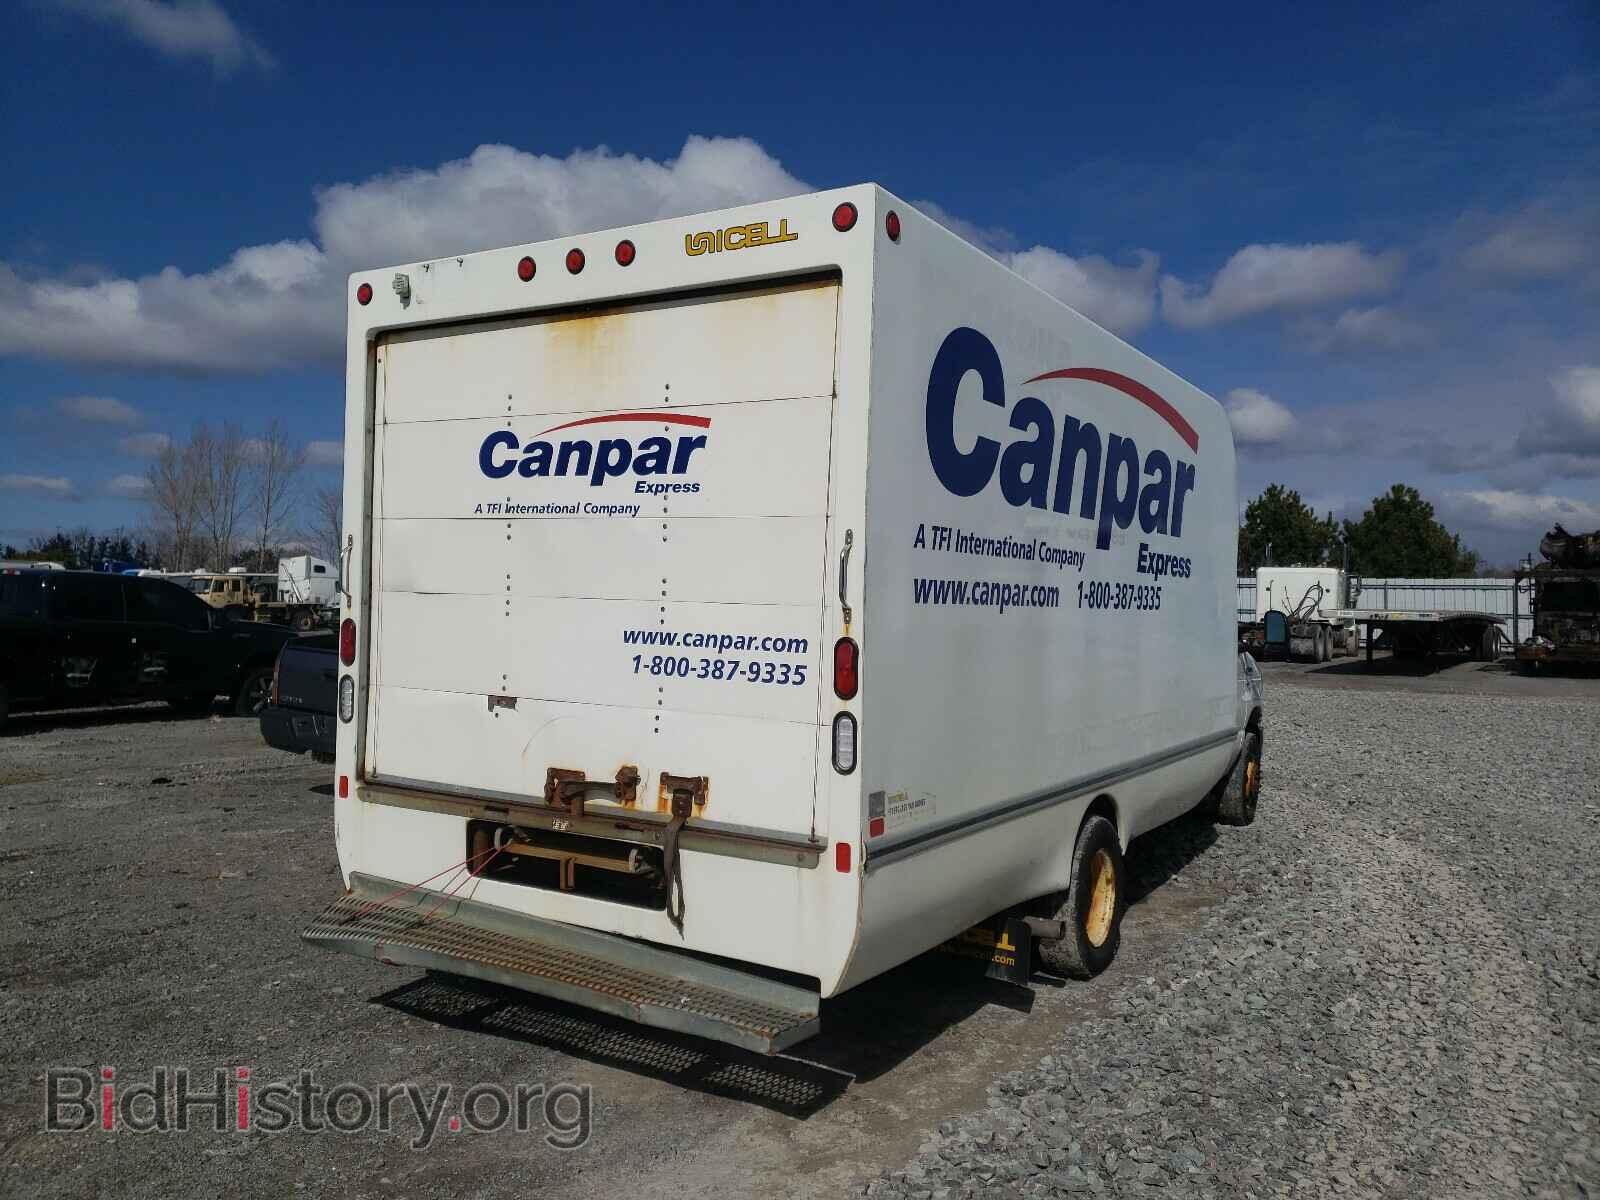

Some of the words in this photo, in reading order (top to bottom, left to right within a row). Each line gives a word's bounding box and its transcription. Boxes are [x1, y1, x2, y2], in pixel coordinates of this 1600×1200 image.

[685, 218, 798, 256] UNICELL
[925, 326, 1196, 550] Canpar
[479, 430, 708, 487] Canpar
[634, 480, 701, 496] Express
[474, 503, 483, 514] A
[486, 503, 501, 514] TFI
[505, 502, 581, 515] International
[583, 502, 641, 518] Company
[913, 523, 926, 549] A
[931, 525, 951, 552] TFI
[955, 528, 1036, 561] International
[1038, 541, 1085, 572] Company
[1136, 542, 1192, 581] Express
[913, 577, 1060, 614] www.canpar.com
[1077, 580, 1162, 610] 1-800-387-9335
[623, 629, 809, 654] www.canpar.com
[632, 654, 808, 686] 1-800-387-9335
